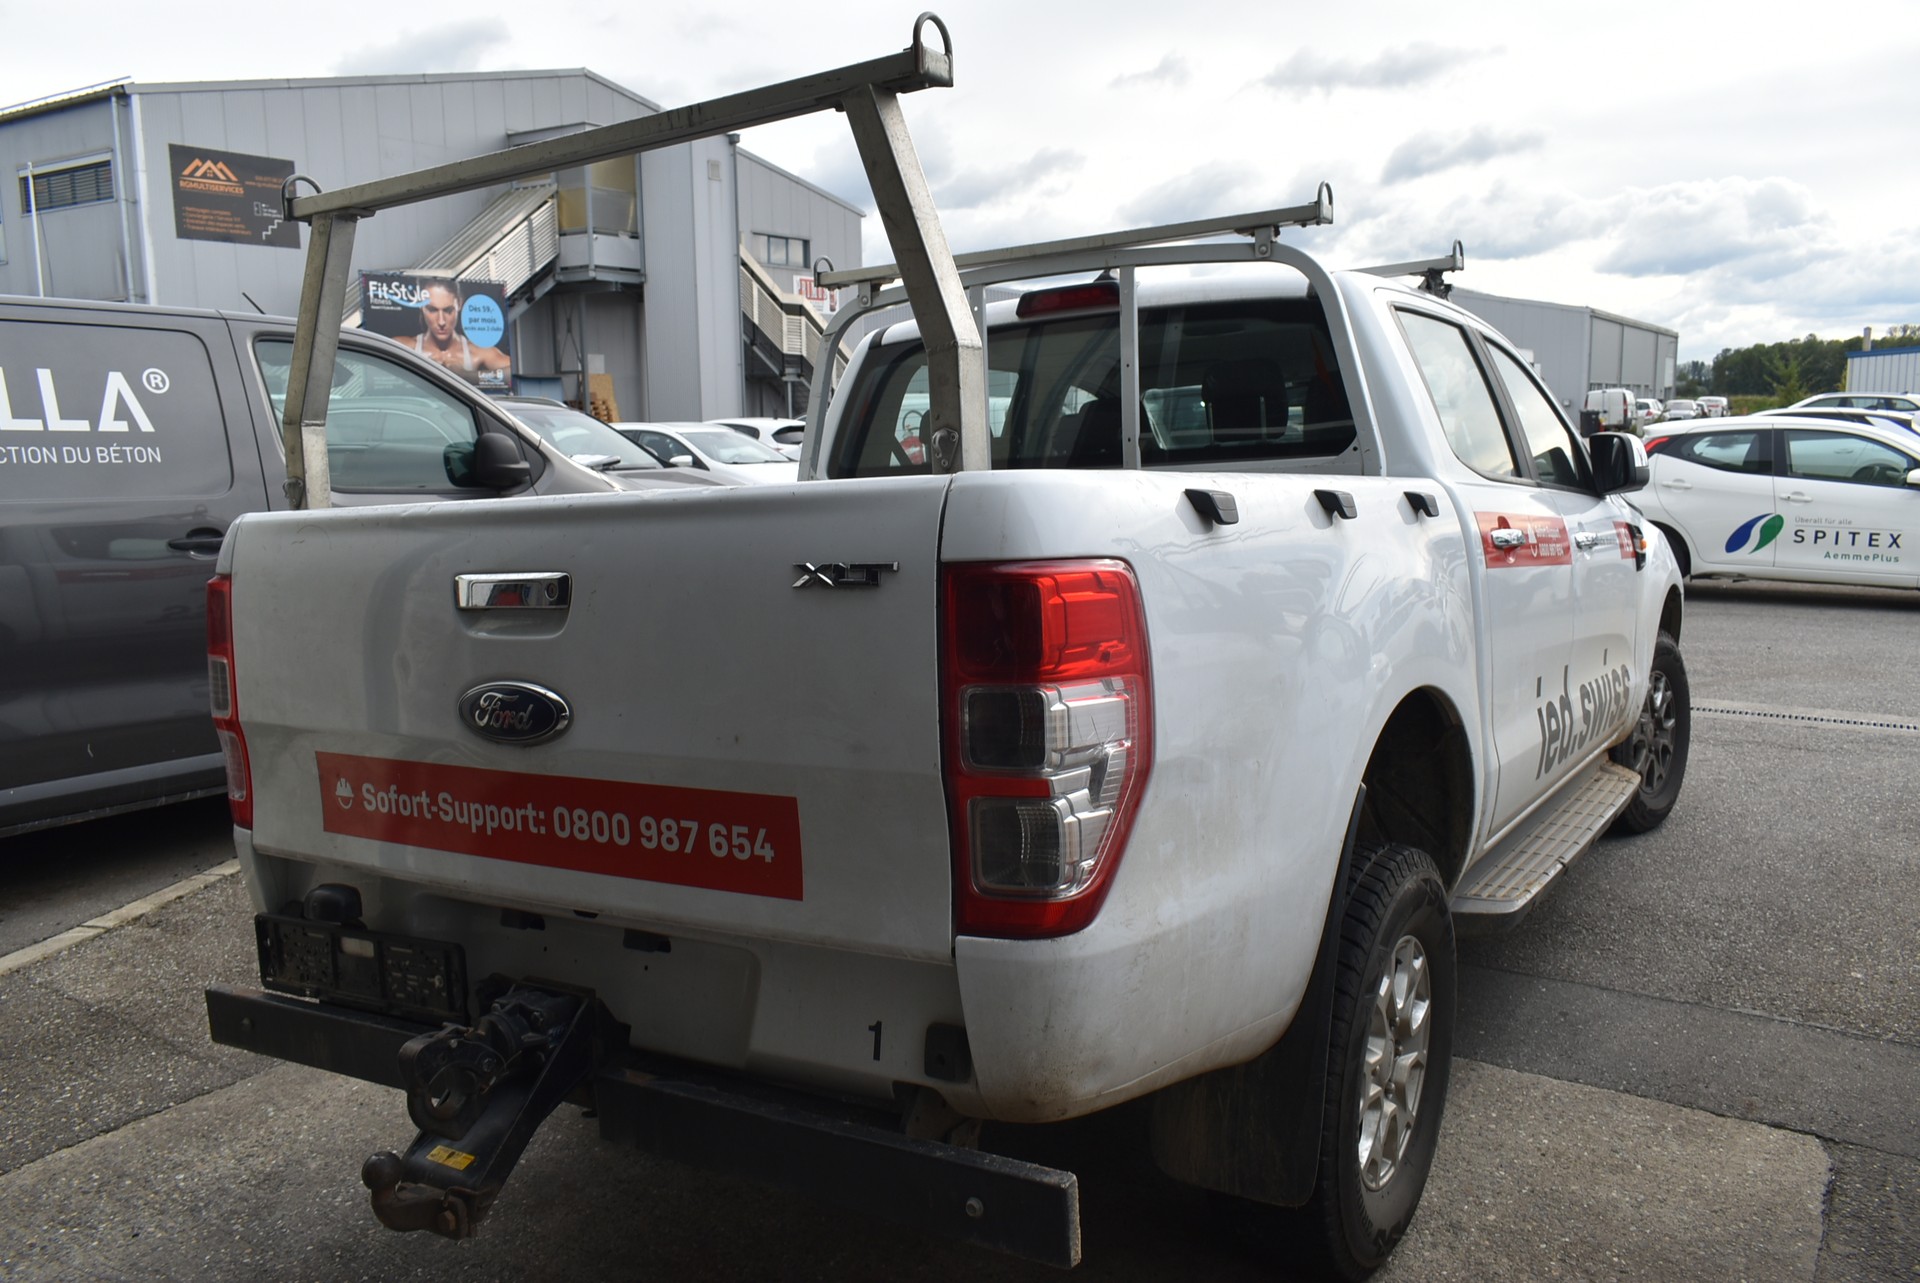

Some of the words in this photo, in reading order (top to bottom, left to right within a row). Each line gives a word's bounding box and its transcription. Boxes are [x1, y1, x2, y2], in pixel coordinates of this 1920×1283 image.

[368, 280, 431, 305] Fit-Style
[468, 317, 481, 325] par
[62, 446, 91, 464] DU
[96, 442, 162, 464] BÉTON
[1794, 515, 1823, 526] Überall
[1824, 516, 1837, 526] für
[1838, 518, 1853, 526] alle
[1793, 529, 1902, 549] SPITEX
[1824, 551, 1900, 563] AemmePlus
[792, 561, 899, 588] XLT
[474, 690, 534, 731] Ford
[1535, 648, 1631, 781] ied.swiss
[361, 782, 546, 836] Sofort-Support:
[552, 806, 631, 846] 0800
[639, 816, 699, 854] 987
[708, 824, 775, 863] 654
[868, 1020, 882, 1061] 1
